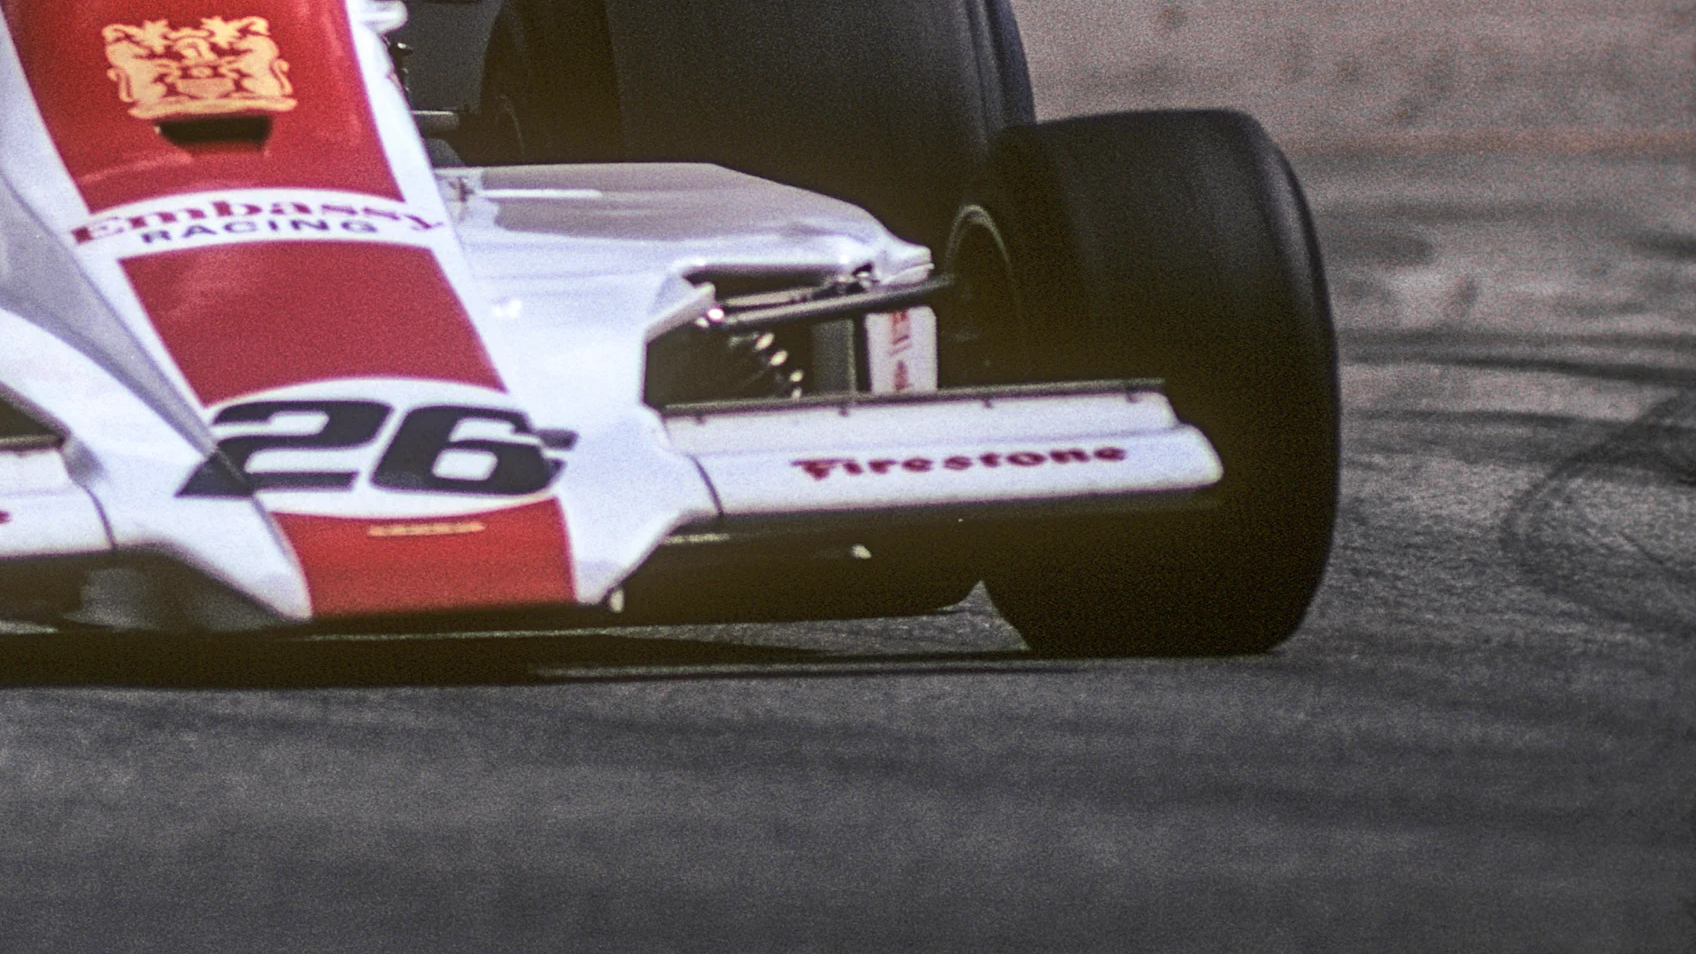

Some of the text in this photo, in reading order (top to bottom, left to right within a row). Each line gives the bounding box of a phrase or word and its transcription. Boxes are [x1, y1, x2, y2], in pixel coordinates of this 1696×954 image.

[71, 200, 444, 245] Embassy
[141, 219, 379, 244] RACING
[174, 399, 578, 498] 26
[791, 445, 1128, 481] Firestone
